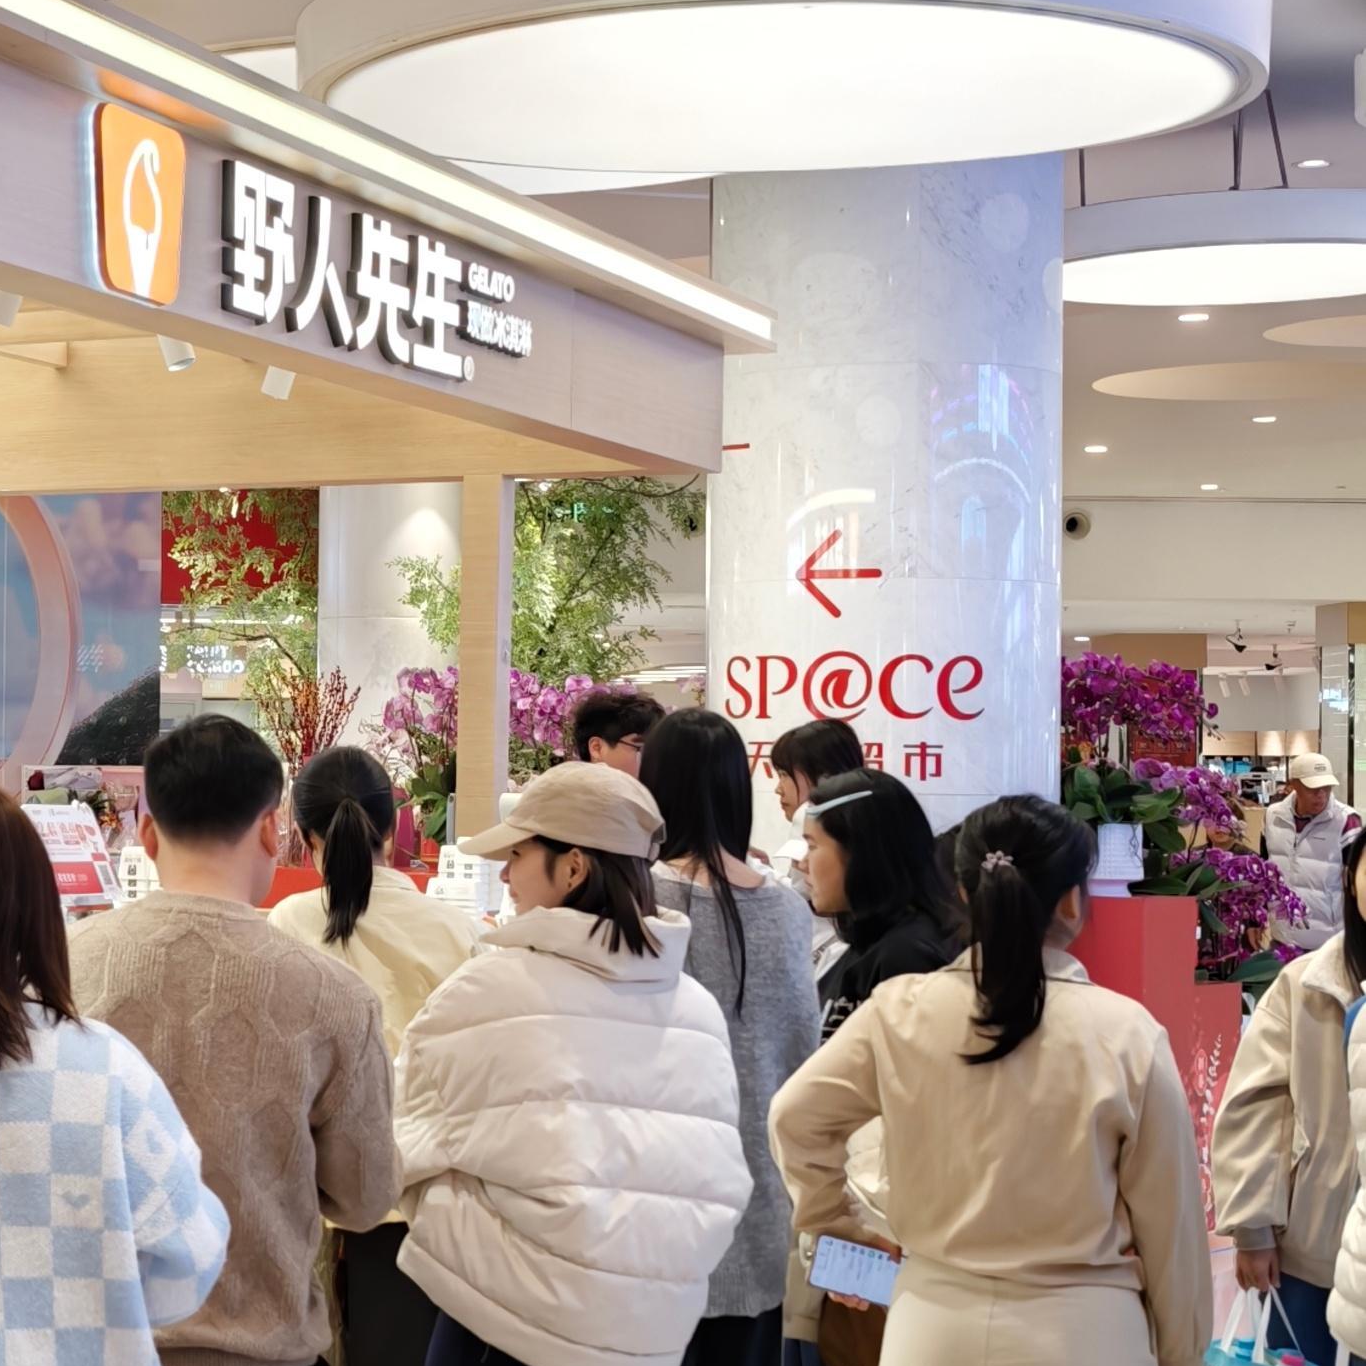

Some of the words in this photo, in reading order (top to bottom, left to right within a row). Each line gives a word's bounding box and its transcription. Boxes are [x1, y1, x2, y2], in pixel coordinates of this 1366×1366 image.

[226, 159, 464, 380] 野人先生
[468, 262, 515, 303] GELATO
